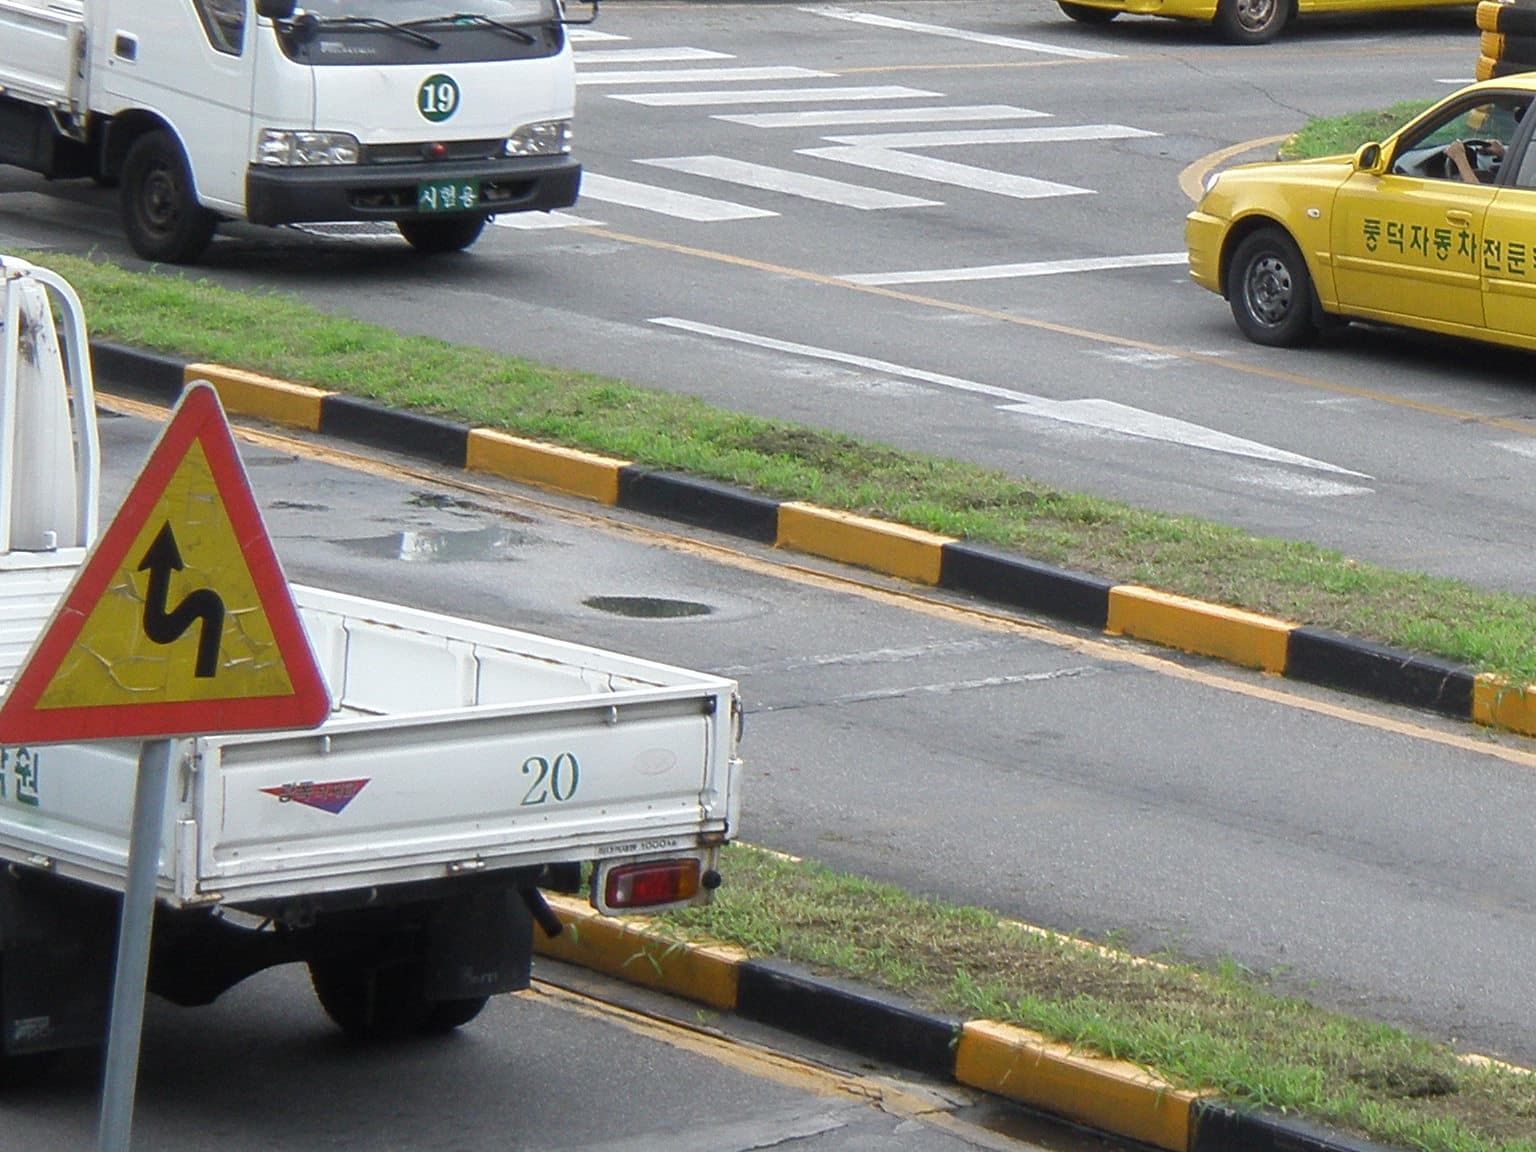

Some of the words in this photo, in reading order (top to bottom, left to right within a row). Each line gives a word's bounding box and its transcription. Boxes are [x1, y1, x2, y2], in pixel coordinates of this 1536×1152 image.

[423, 83, 455, 113] 19
[419, 184, 477, 210] 시험용
[520, 752, 579, 806] 20
